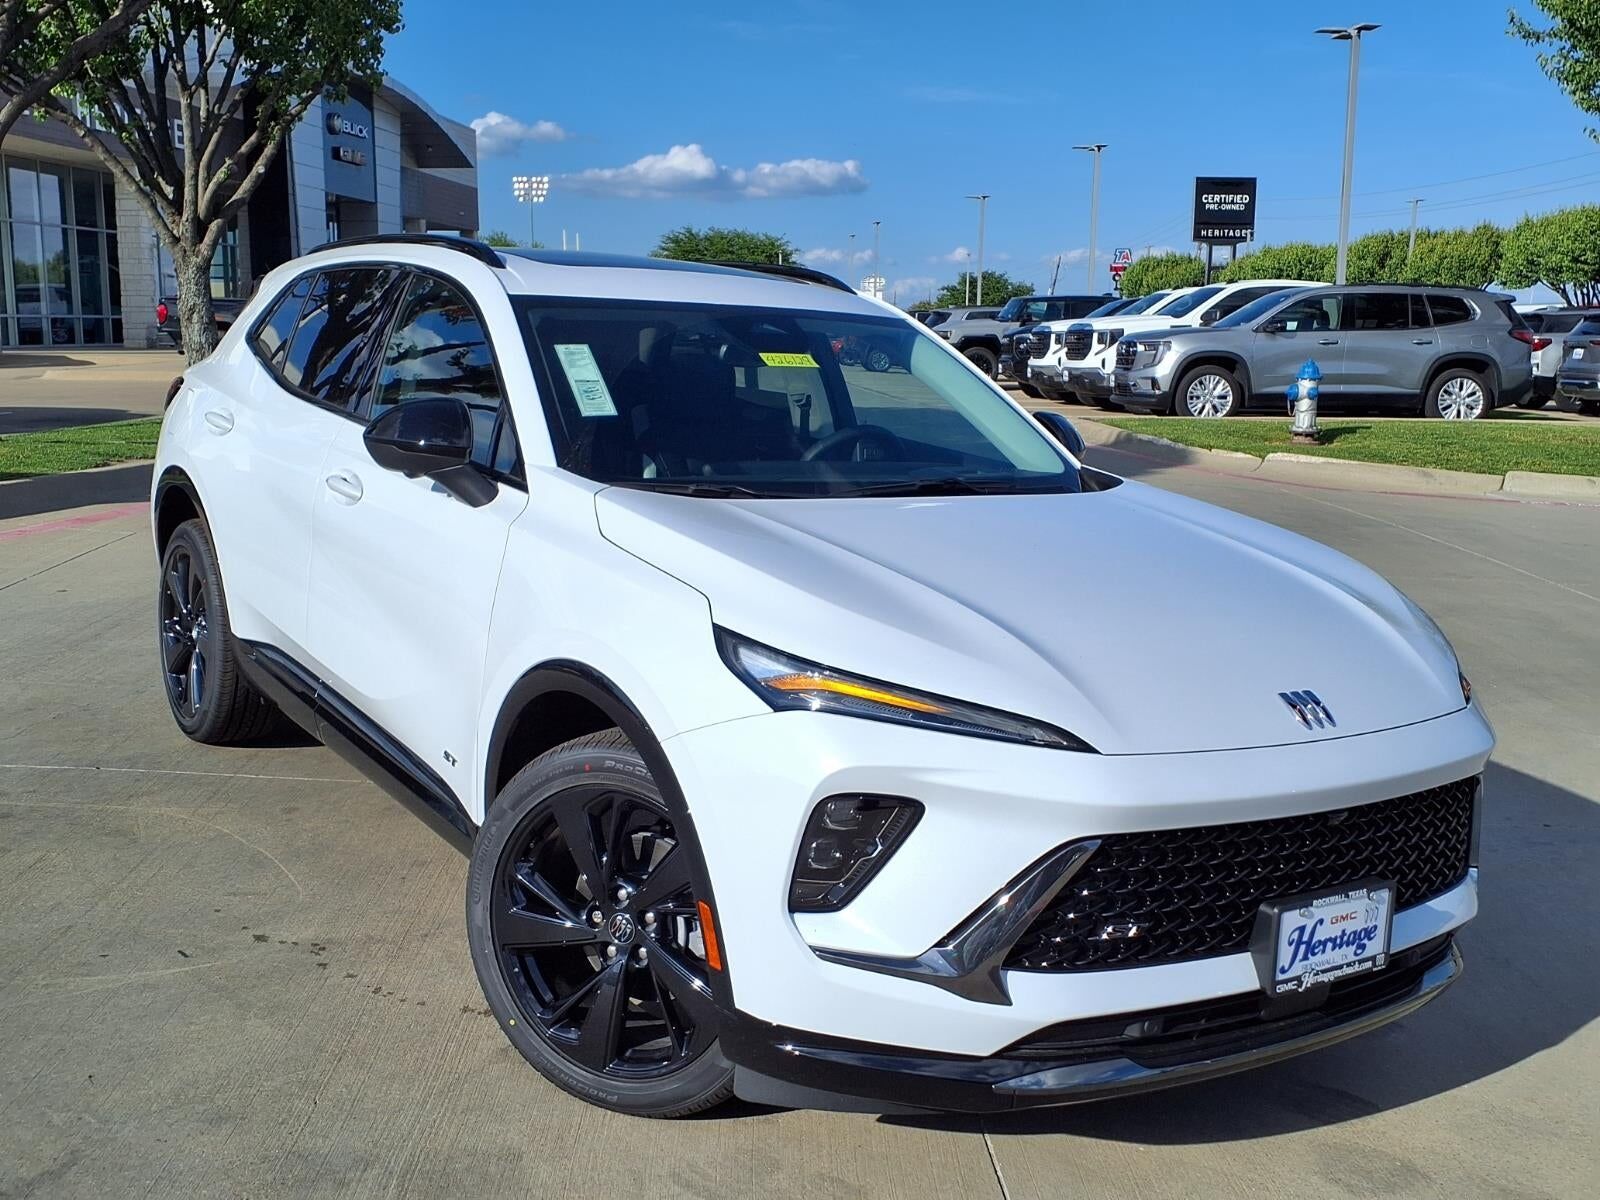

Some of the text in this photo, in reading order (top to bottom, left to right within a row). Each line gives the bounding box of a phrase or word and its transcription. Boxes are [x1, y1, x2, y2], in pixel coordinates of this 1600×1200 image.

[343, 119, 369, 139] BUICK
[1202, 194, 1250, 204] CERTIFIED
[1205, 203, 1246, 211] PRE-OWNED
[1201, 229, 1247, 237] HERITAGE
[1114, 249, 1132, 263] TA
[443, 750, 458, 768] ST
[1347, 888, 1368, 901] TEXAS
[1330, 911, 1359, 925] GMC
[1279, 917, 1379, 975] Heritage
[1276, 981, 1299, 993] GMC
